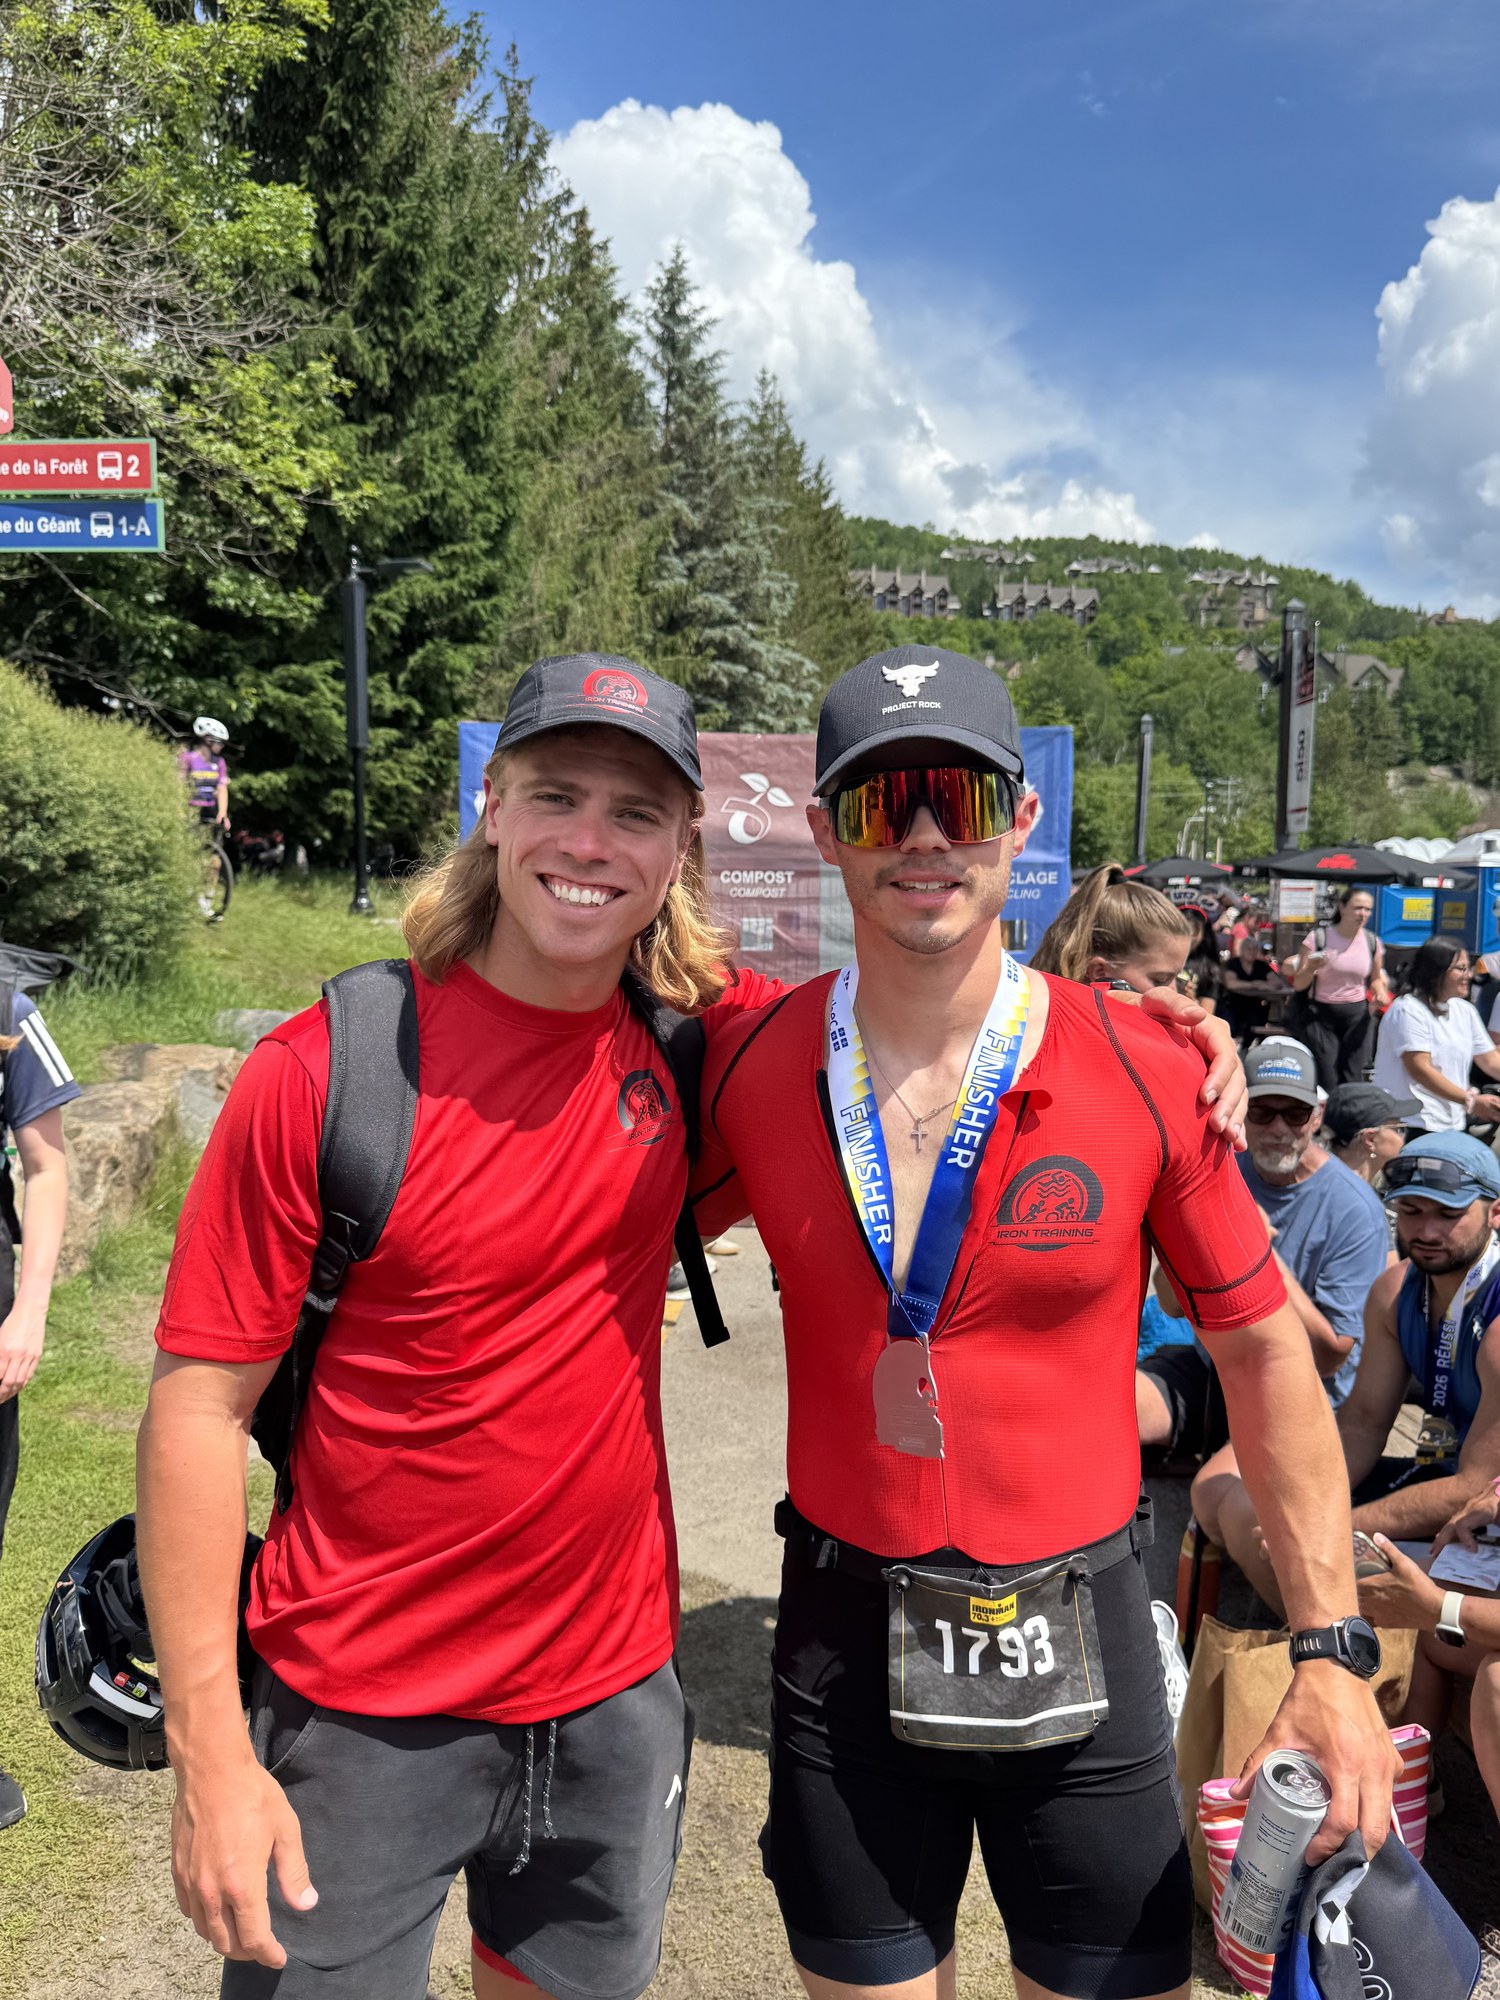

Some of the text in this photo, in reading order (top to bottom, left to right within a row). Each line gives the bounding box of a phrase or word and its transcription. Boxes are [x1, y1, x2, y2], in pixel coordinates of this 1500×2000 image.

[12, 459, 31, 475] de
[34, 459, 47, 475] la
[50, 458, 88, 475] Forêt
[127, 455, 140, 477] 2
[14, 517, 33, 533] du
[37, 516, 81, 533] Géant
[118, 516, 151, 536] 1-A
[606, 698, 644, 713] TRAINING
[881, 701, 941, 715] PROJECT ROCK
[720, 870, 794, 884] COMPOST
[729, 887, 786, 899] COMPOST
[947, 1029, 1012, 1169] FINISHER
[839, 1101, 892, 1246] FINISHER
[996, 1228, 1094, 1239] IRON TRAINING
[1432, 1374, 1448, 1407] 2026
[972, 1602, 1014, 1615] IRONMAN
[972, 1612, 989, 1622] 70.3
[935, 1615, 1054, 1678] 1793
